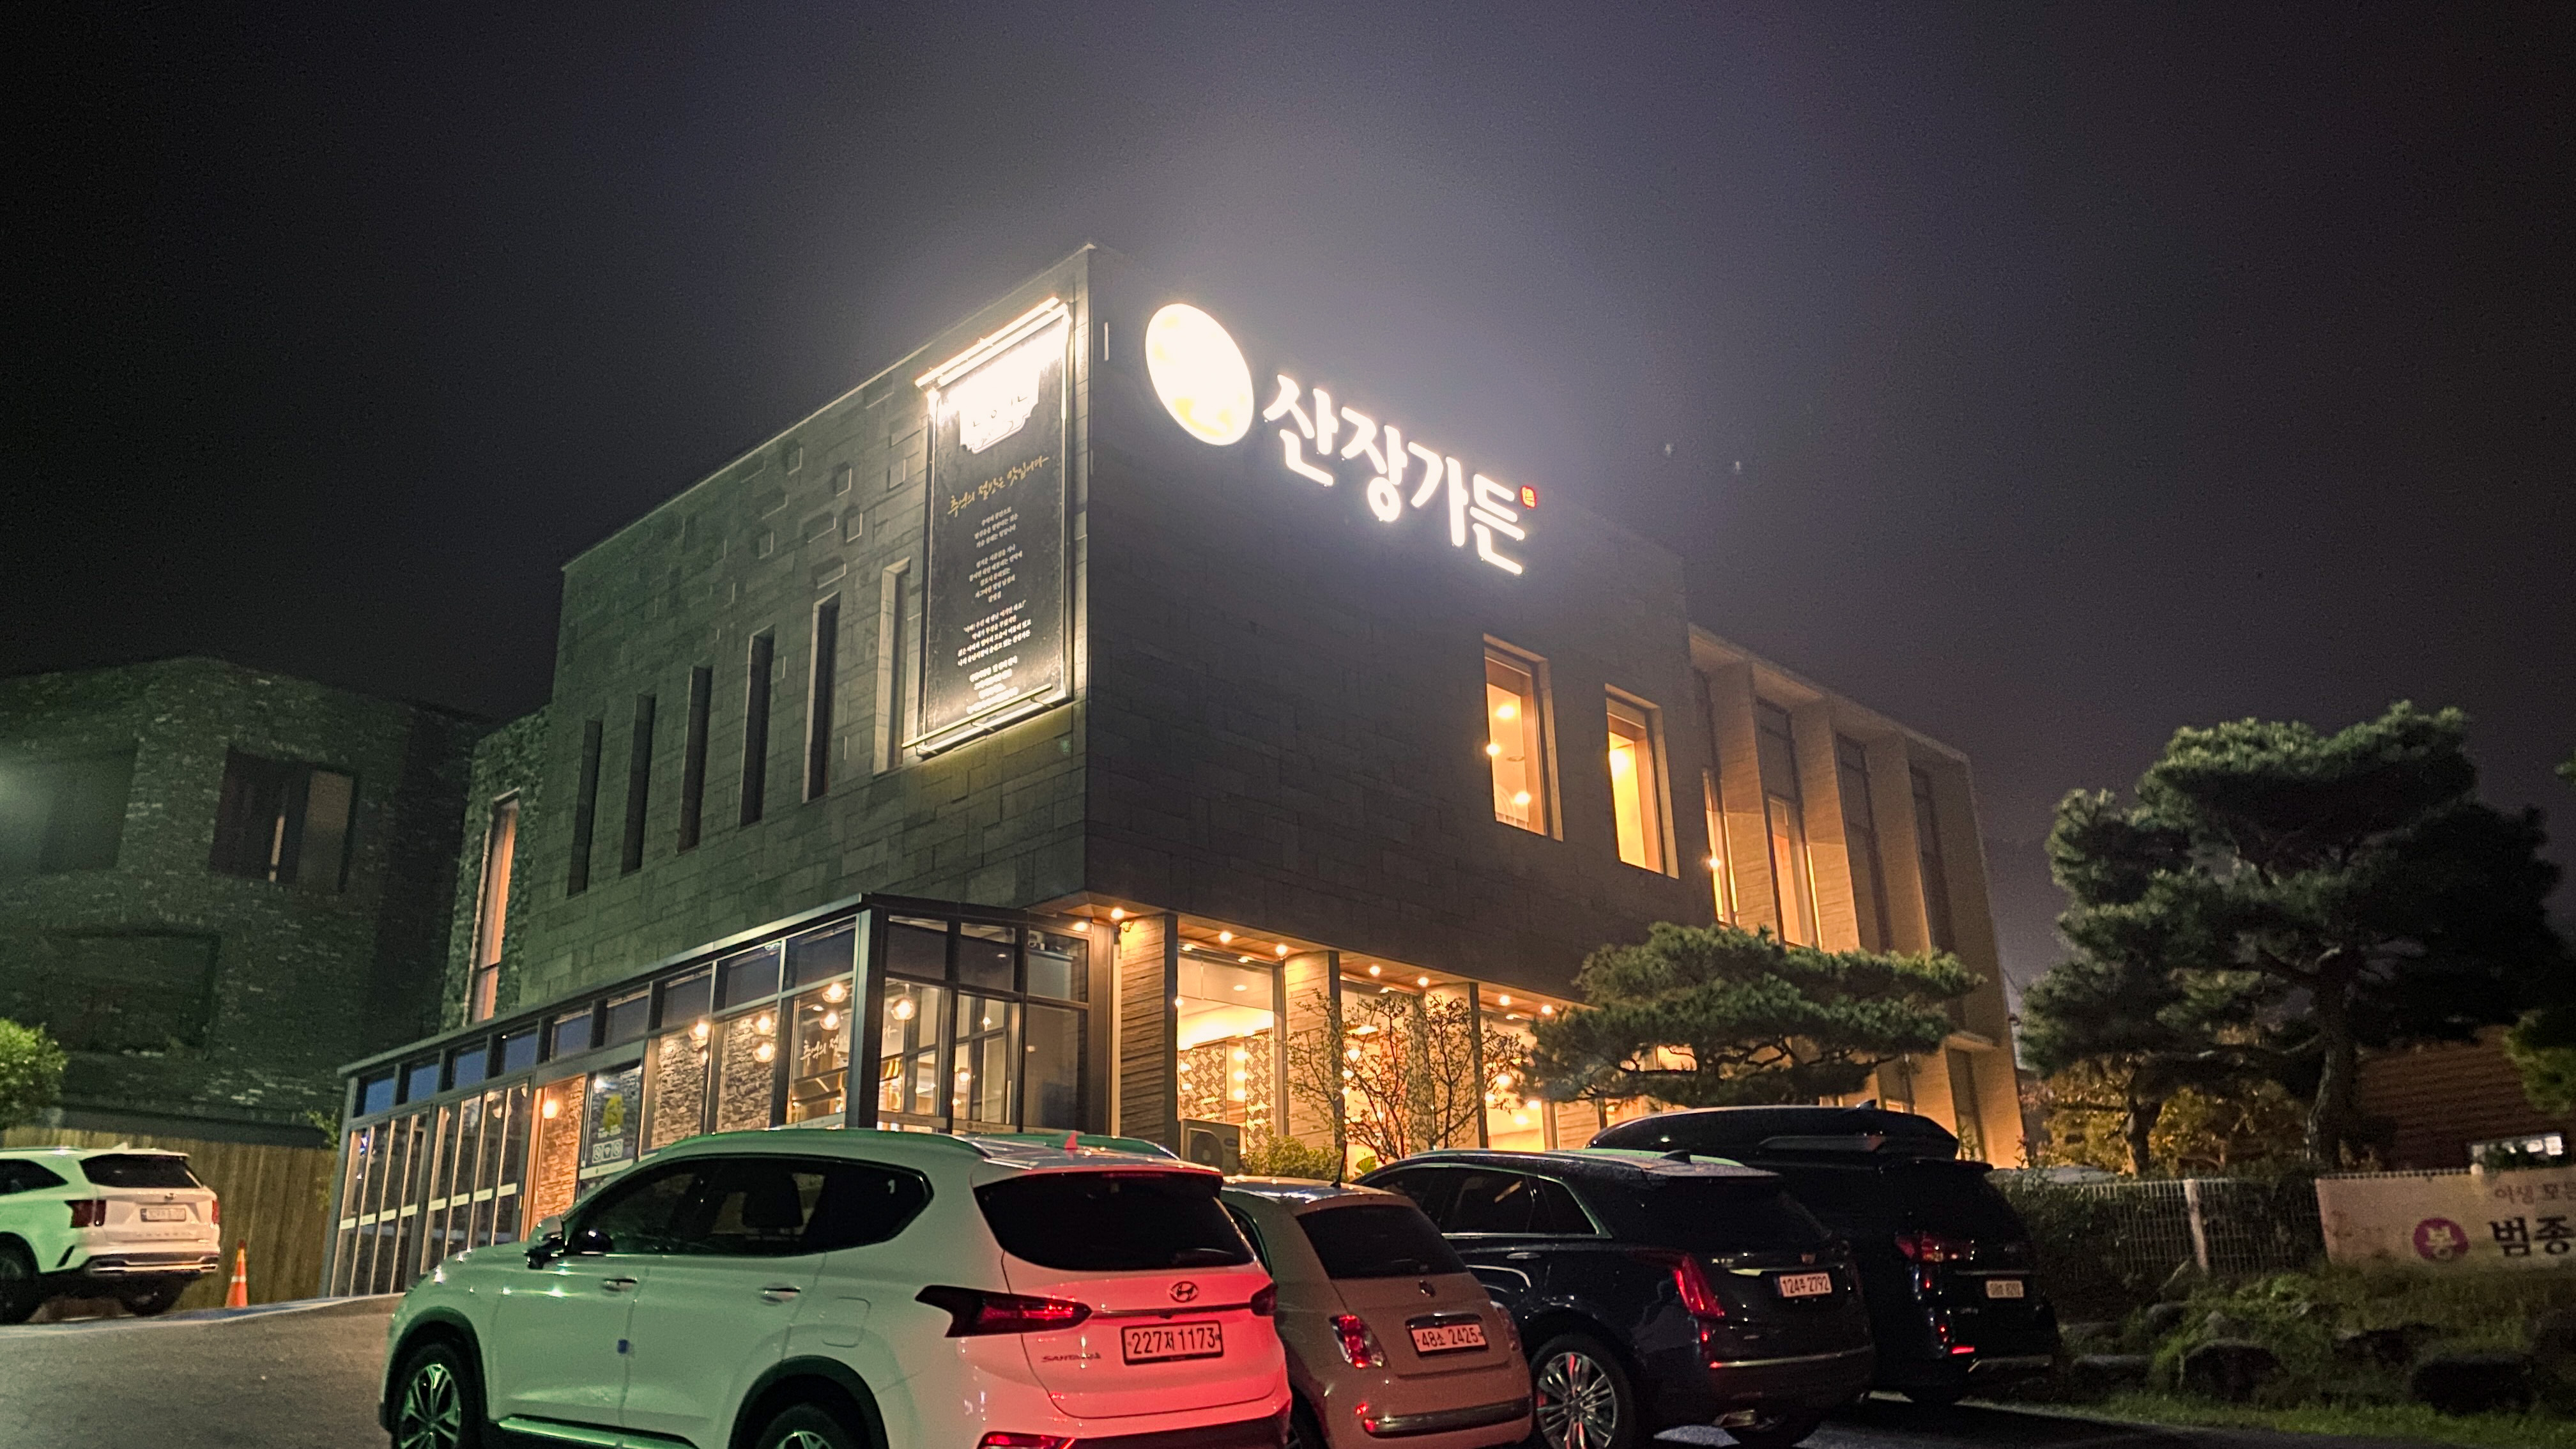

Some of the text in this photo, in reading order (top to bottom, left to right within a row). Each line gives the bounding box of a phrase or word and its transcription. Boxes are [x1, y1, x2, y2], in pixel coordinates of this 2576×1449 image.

[1263, 374, 1524, 574] 산장가든
[947, 491, 975, 518] 추억의
[800, 1039, 827, 1066] 추억의
[1807, 1276, 1829, 1292] 2792
[1448, 1328, 1479, 1345] 2425
